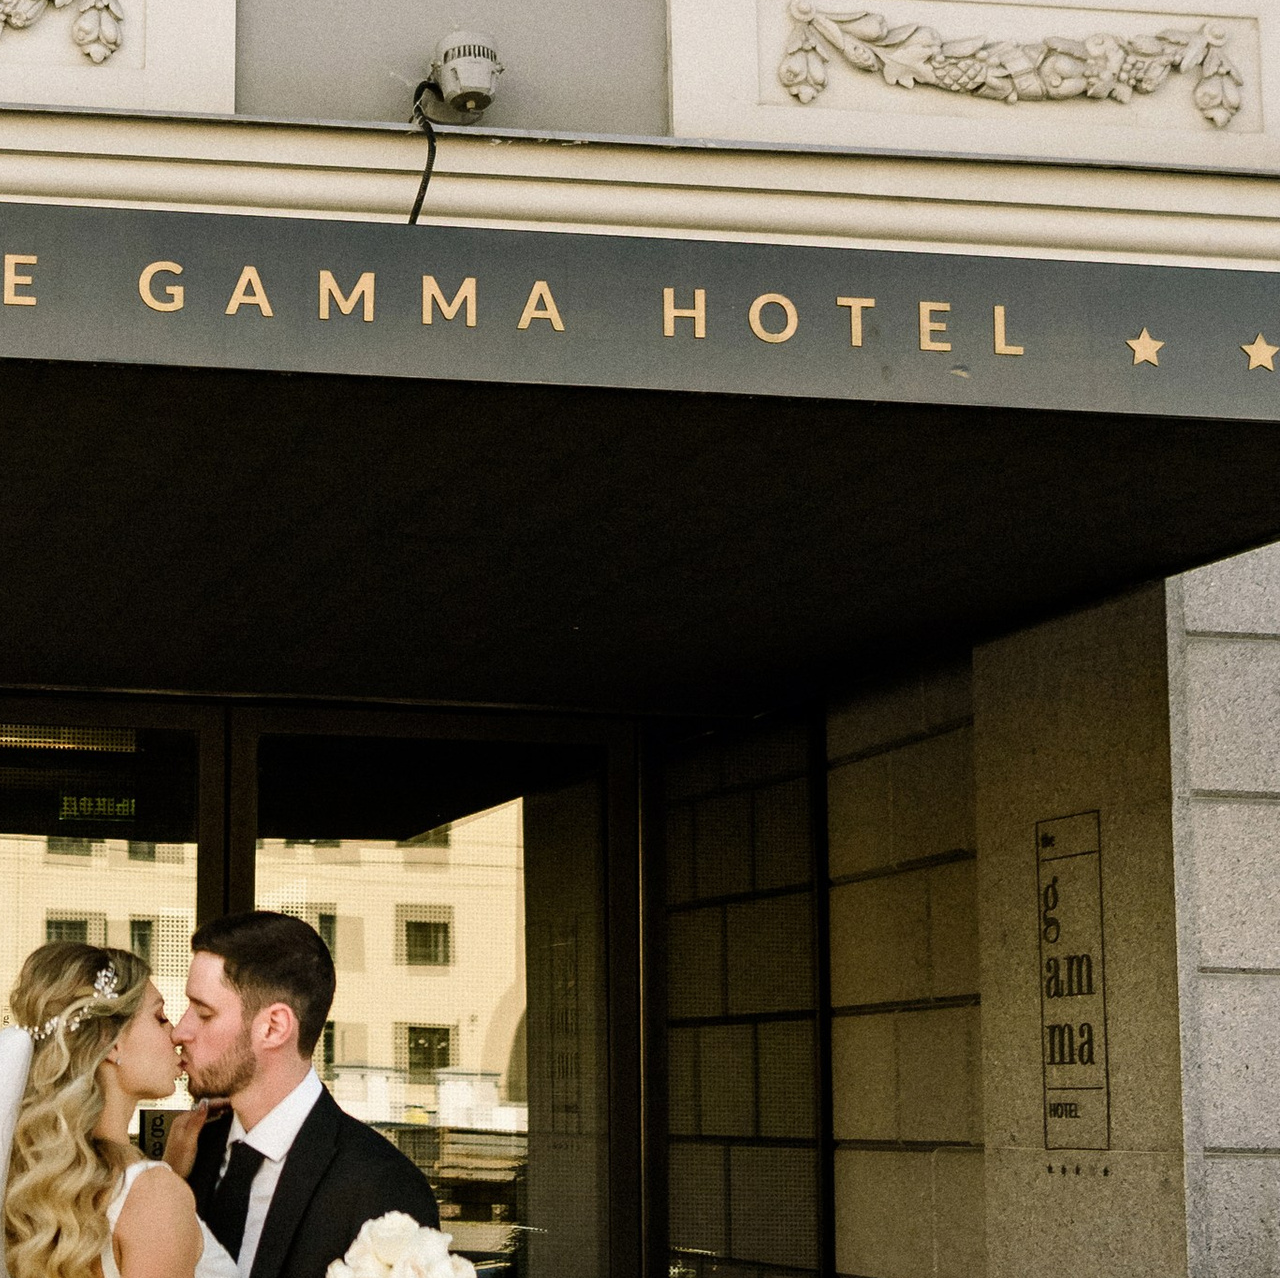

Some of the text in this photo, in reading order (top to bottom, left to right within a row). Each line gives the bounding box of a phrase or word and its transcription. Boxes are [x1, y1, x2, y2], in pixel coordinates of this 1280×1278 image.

[137, 260, 566, 332] GAMMA
[662, 287, 1025, 356] HOTEL
[1048, 1102, 1081, 1119] HOTEL
